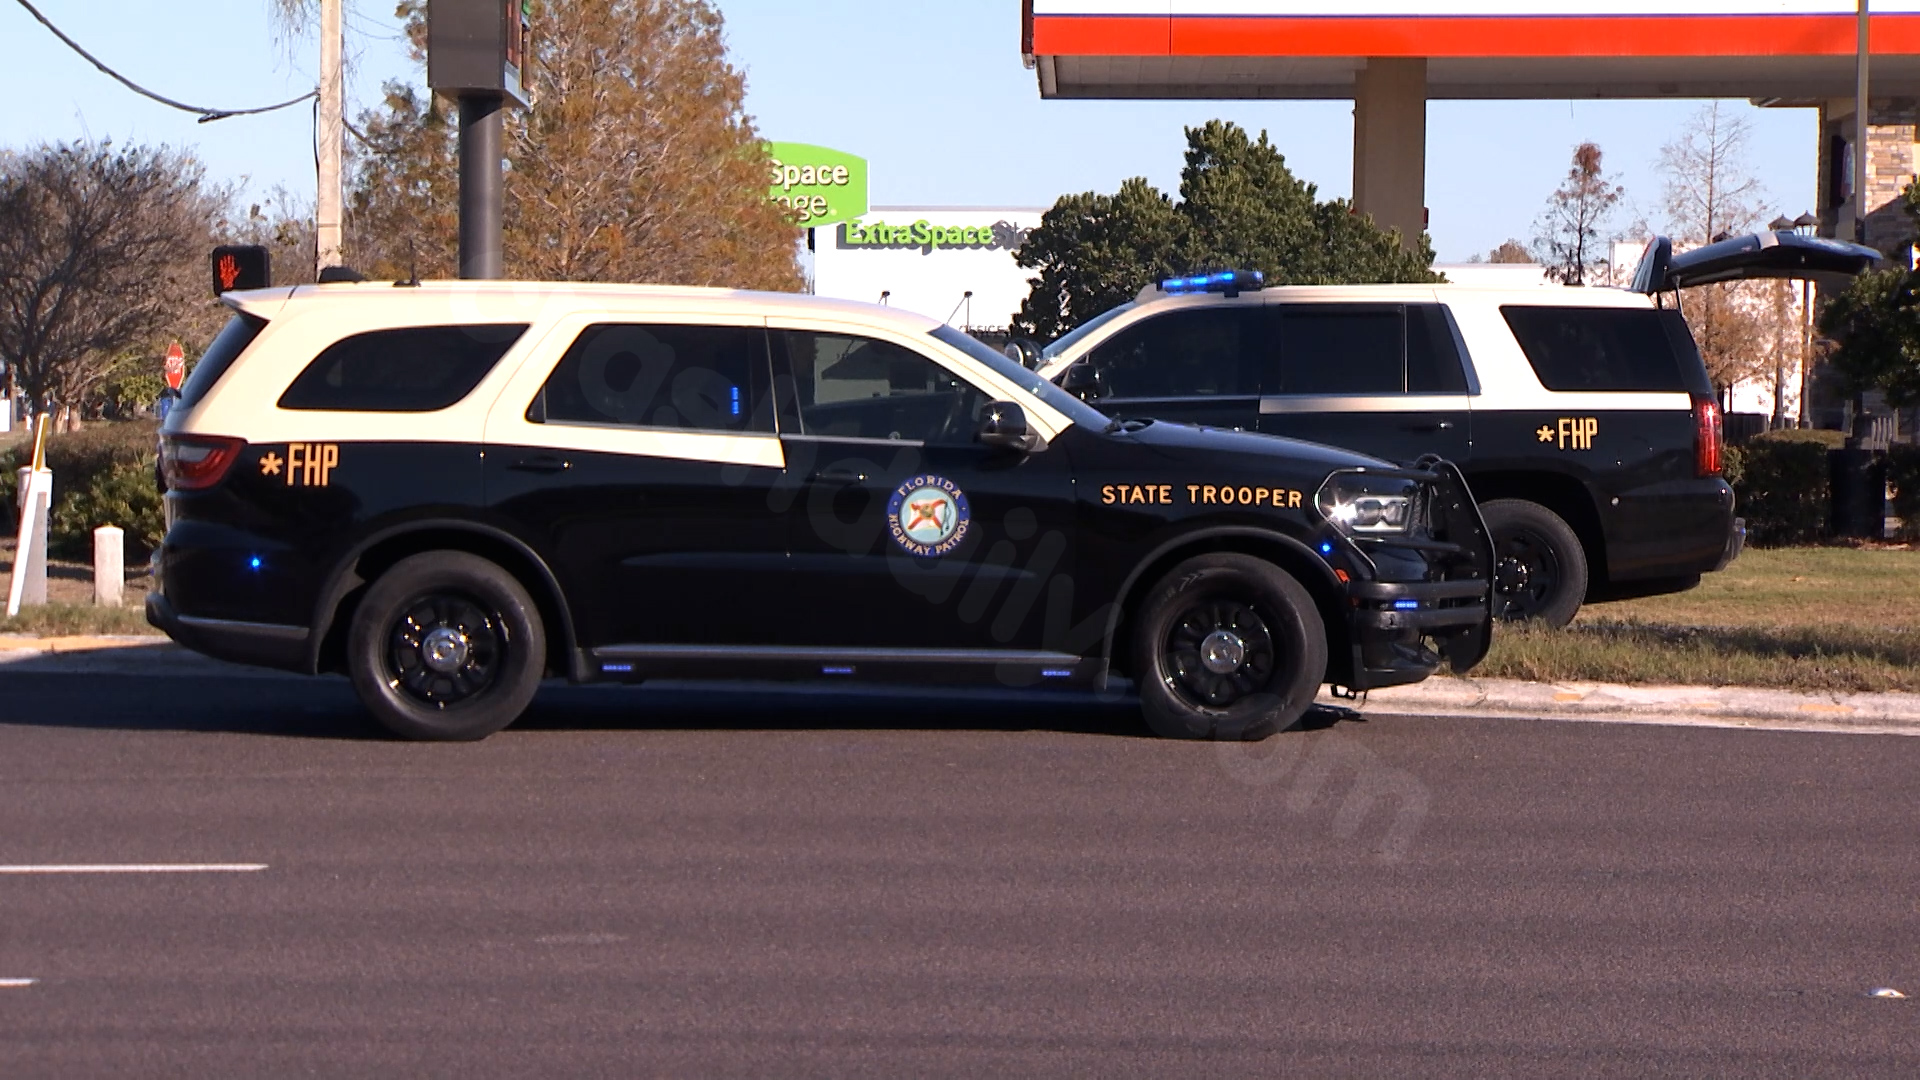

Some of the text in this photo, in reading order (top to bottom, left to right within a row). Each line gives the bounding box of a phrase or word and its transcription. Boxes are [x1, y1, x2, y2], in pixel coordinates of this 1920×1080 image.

[769, 159, 849, 191] Space
[845, 218, 993, 250] ExtraSpace
[898, 475, 962, 500] FLORIDA
[1102, 485, 1303, 508] STATE TROOPER
[888, 513, 970, 556] HIGHWAY PATROL
